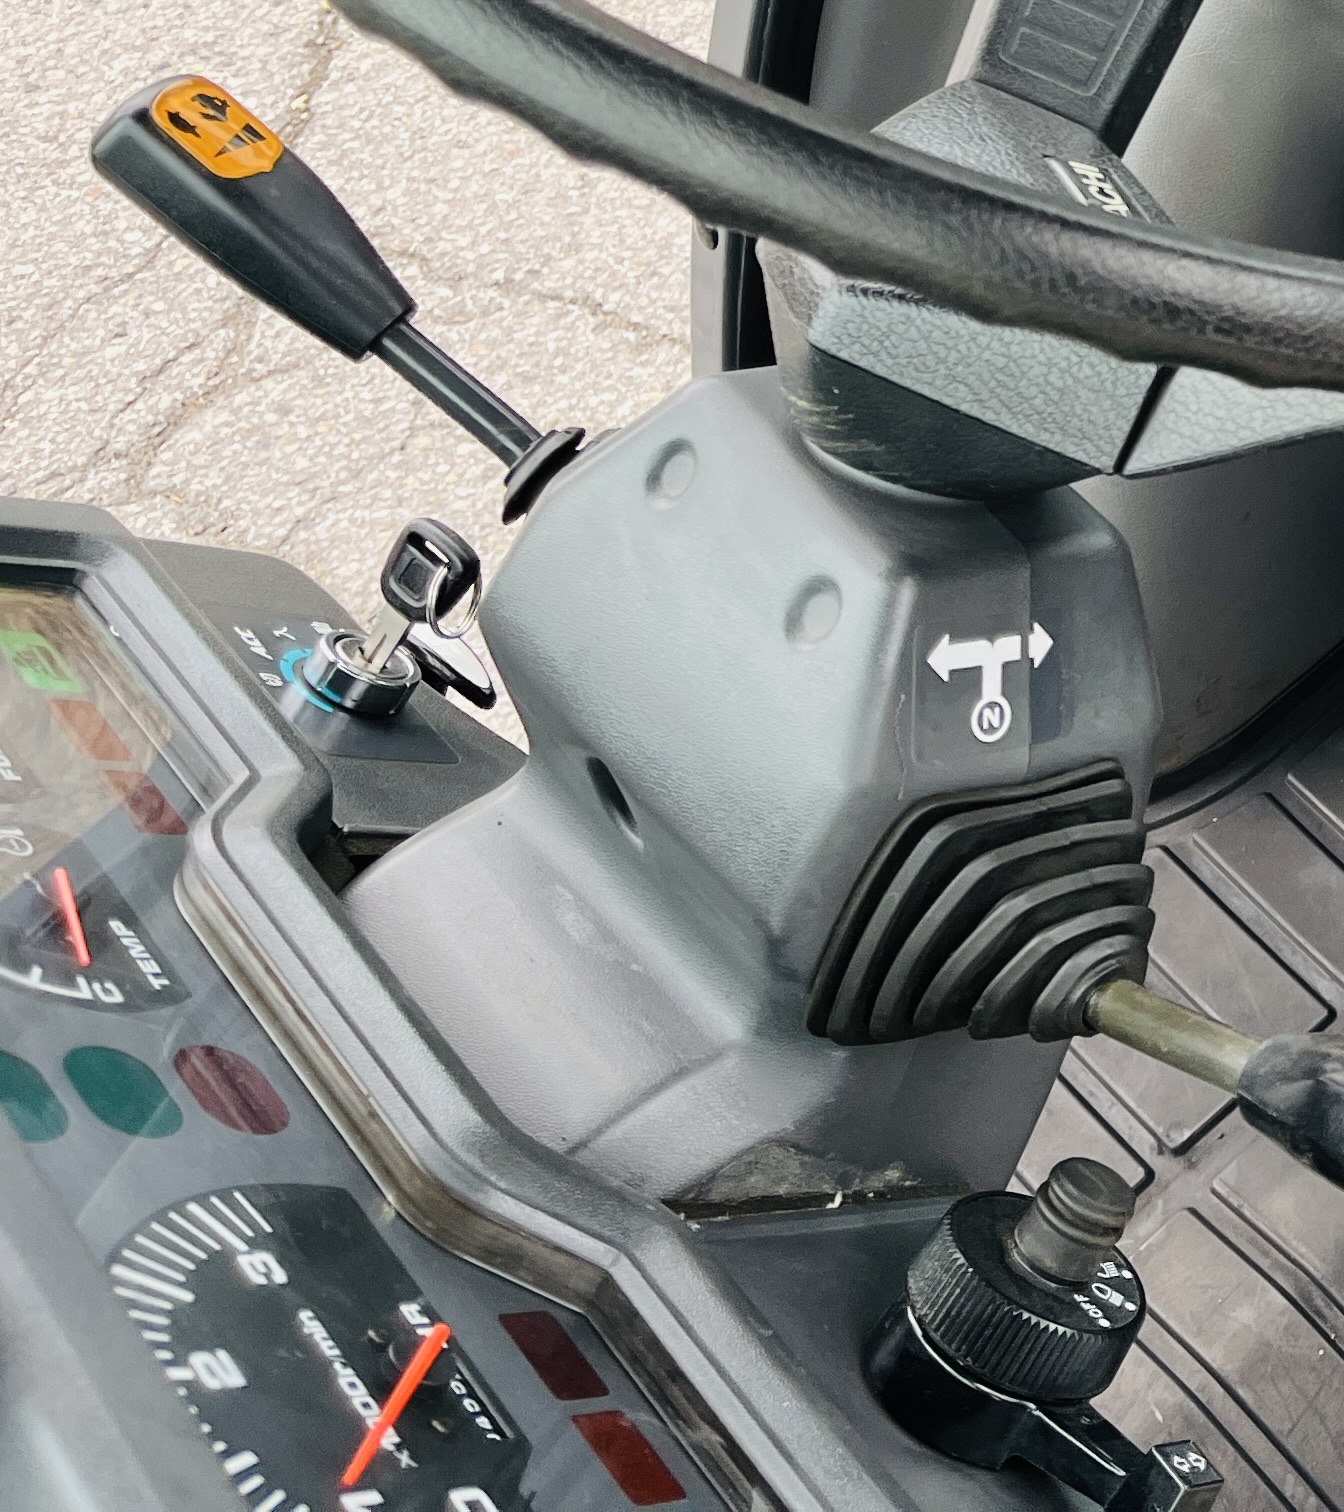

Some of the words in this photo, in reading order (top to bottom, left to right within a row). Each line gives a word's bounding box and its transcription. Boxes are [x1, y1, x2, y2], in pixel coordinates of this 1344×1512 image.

[108, 917, 172, 991] TEMP
[91, 978, 126, 1004] C
[237, 1250, 289, 1286] 3
[1073, 1293, 1104, 1319] OFF
[188, 1347, 248, 1390] 2
